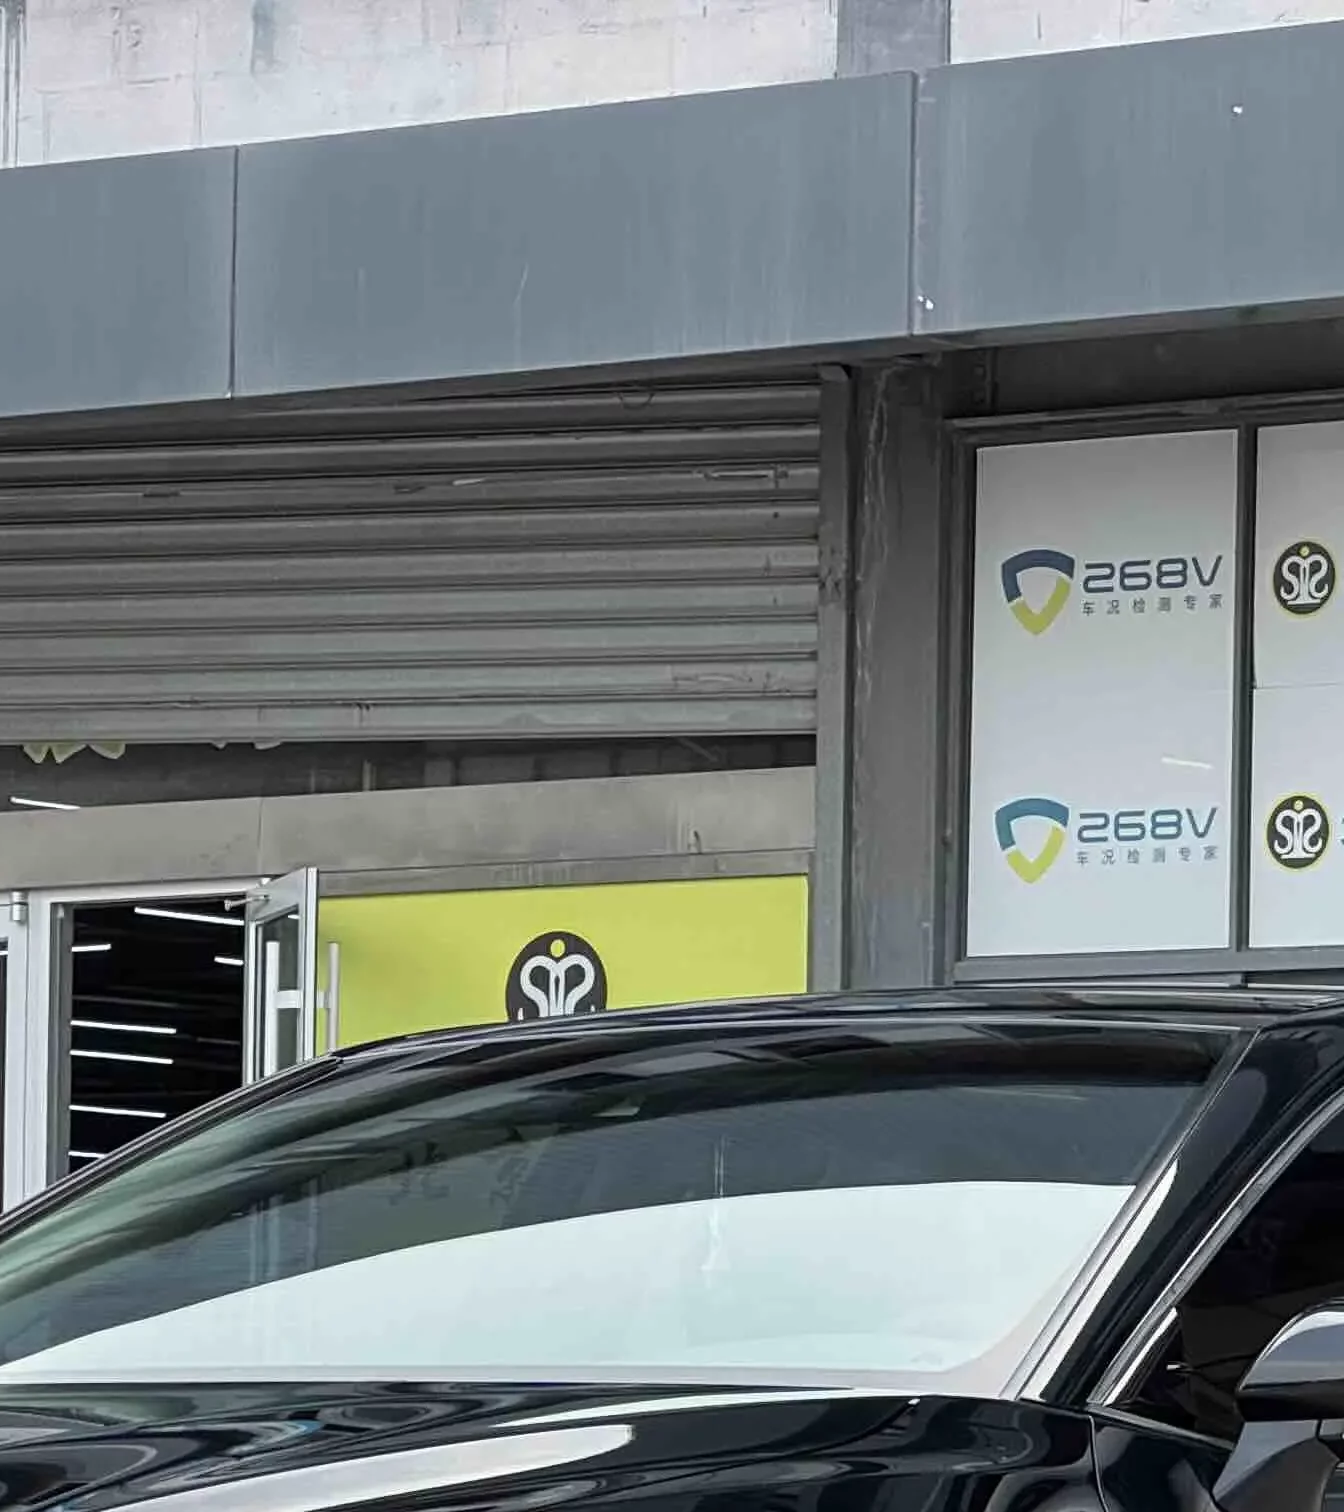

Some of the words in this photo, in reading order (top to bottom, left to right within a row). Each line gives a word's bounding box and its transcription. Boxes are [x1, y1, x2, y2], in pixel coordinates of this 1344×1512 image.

[1083, 555, 1223, 593] 268V
[1081, 593, 1223, 616] 车况检测专家
[1077, 807, 1218, 843] 268V
[1076, 846, 1218, 867] 车况检测专家
